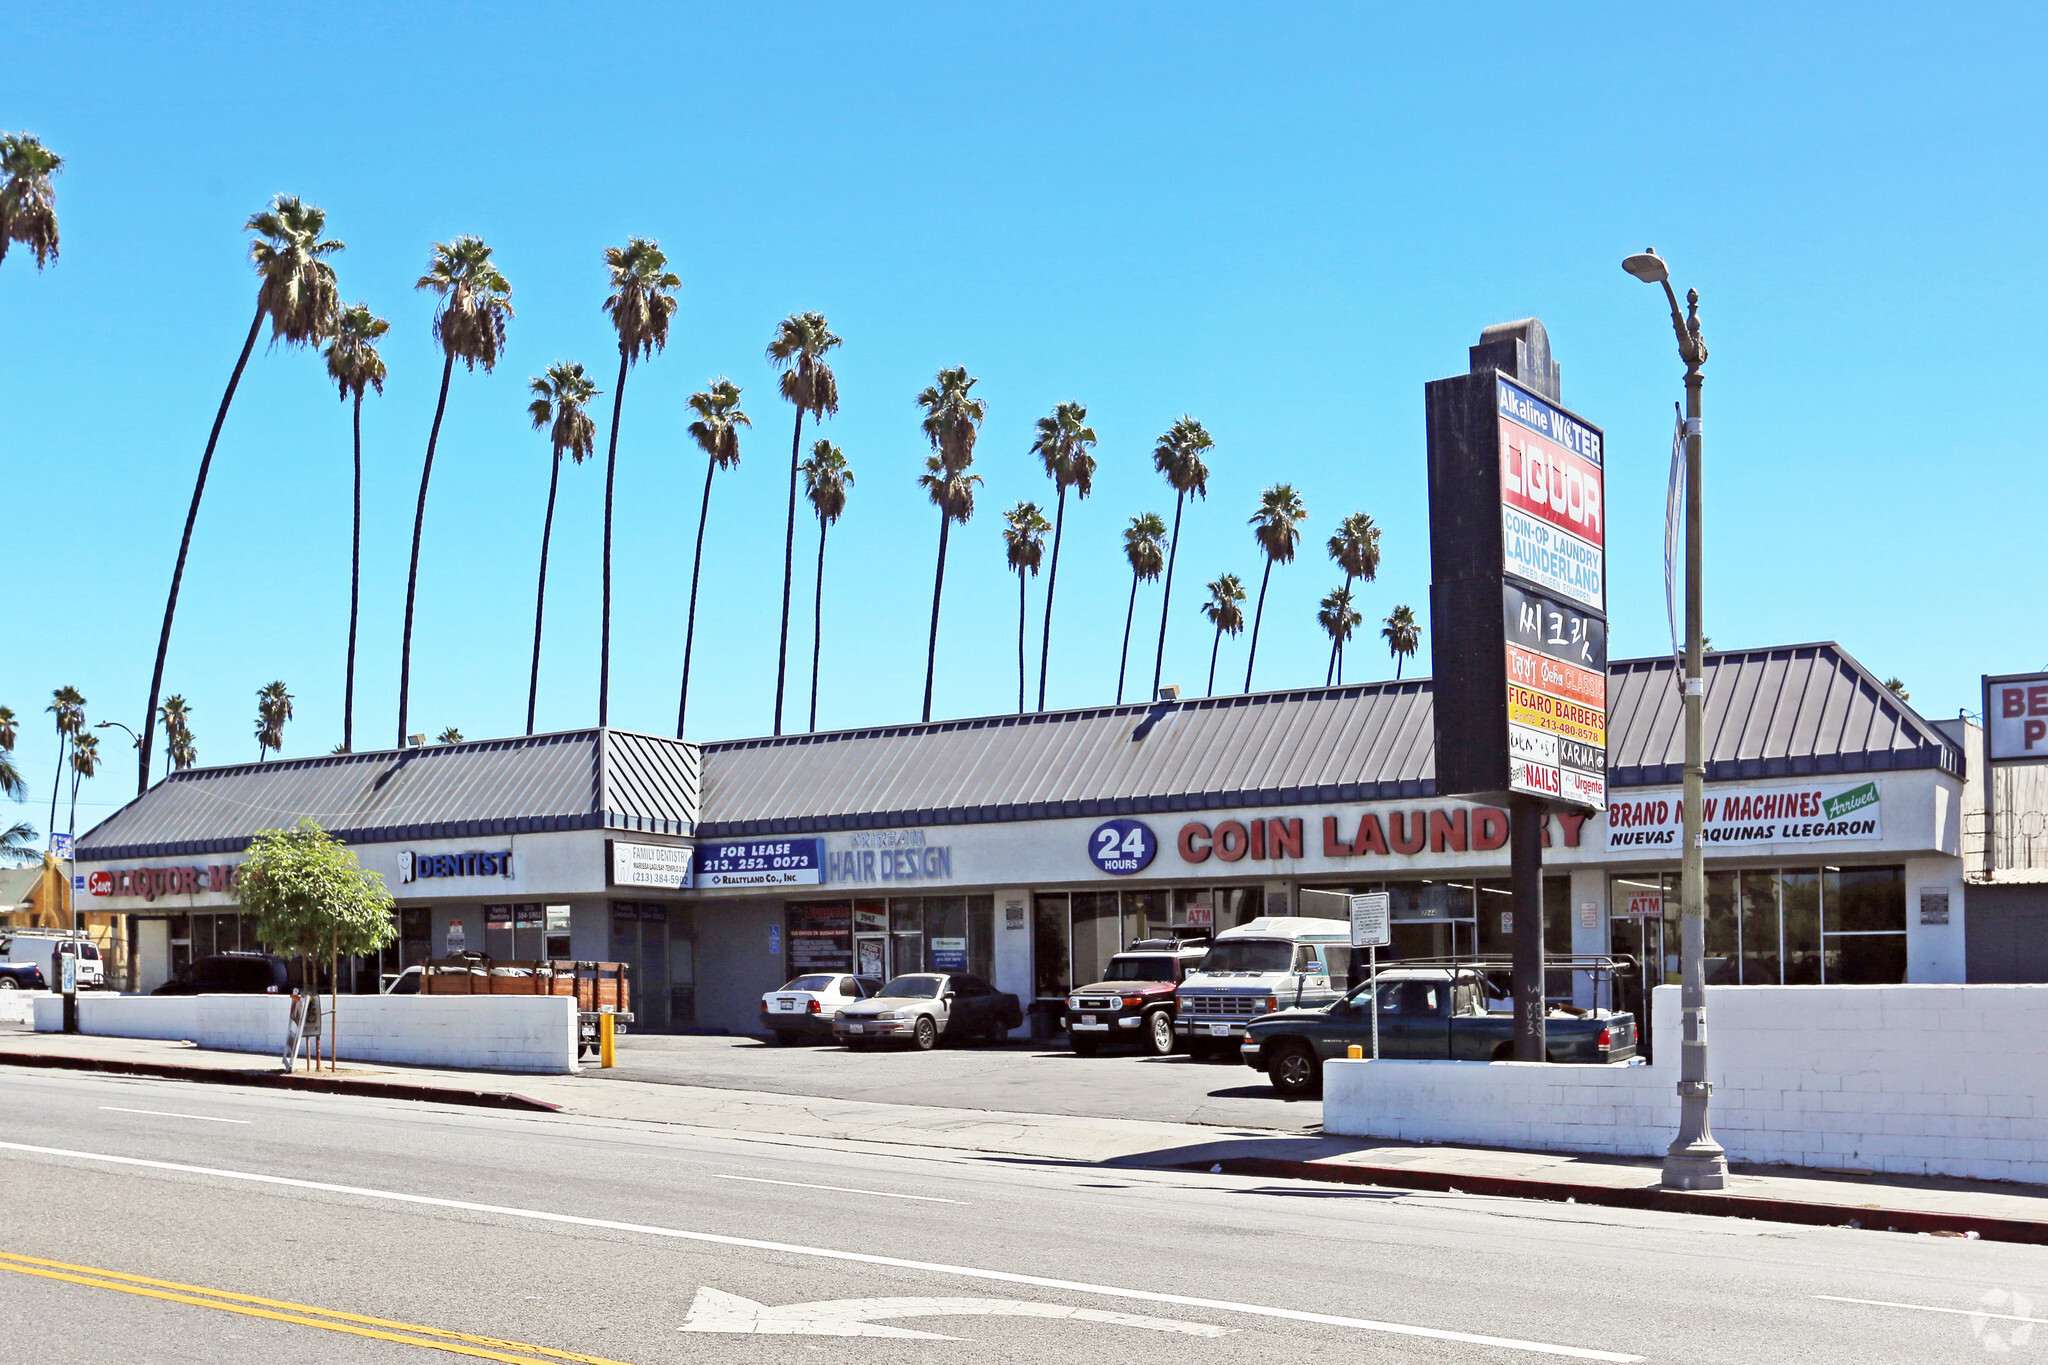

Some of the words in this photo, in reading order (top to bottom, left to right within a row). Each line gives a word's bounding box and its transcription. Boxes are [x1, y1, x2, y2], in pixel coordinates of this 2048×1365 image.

[1500, 386, 1548, 430] Alkaline
[1503, 431, 1600, 533] LIQUOR
[1505, 512, 1549, 546] COIN-OP
[1554, 534, 1599, 569] LAUNDRY
[1505, 531, 1600, 595] LAUNDERLAND
[1518, 564, 1538, 579] SPEED
[1541, 574, 1561, 590] QUEEN
[1563, 583, 1591, 603] EQUIPPED
[1519, 601, 1594, 663] 씨크릿
[1564, 667, 1604, 700] CLASSIC
[1508, 687, 1552, 714] FIGARO
[1555, 701, 1604, 731] BARBERS
[1540, 717, 1599, 742] 213-480-8578
[1561, 740, 1595, 767] KARMA
[1526, 763, 1559, 793] NAILS
[1574, 774, 1603, 795] Urgente
[1609, 800, 1669, 828] BRAND
[1675, 798, 1718, 826] NW
[1722, 791, 1822, 822] MACHINES
[1830, 786, 1876, 816] Arrived
[1097, 828, 1145, 859] 24
[1178, 818, 1303, 863] COIN
[1323, 808, 1586, 857] LAUNDY
[1611, 830, 1675, 846] NUEVAS
[1701, 825, 1776, 841] AQUINAS
[1782, 820, 1876, 838] LLEGARON
[418, 851, 510, 878] DENTIST
[632, 847, 655, 861] FAMILY
[656, 849, 688, 863] DENTISTRY
[703, 860, 733, 871] 213.
[738, 858, 768, 870] 252.
[773, 856, 809, 868] 0073
[720, 847, 745, 857] FOR
[751, 843, 791, 856] LEASE
[829, 850, 876, 882] HAIR
[880, 846, 952, 881] DESIGN
[1105, 859, 1138, 870] HOURS
[112, 867, 198, 902] LIQUOR
[632, 872, 653, 884] (213)
[654, 873, 689, 885] 384-5902
[1188, 910, 1211, 921] ATM
[1630, 897, 1660, 912] ATM
[864, 944, 878, 953] FOR
